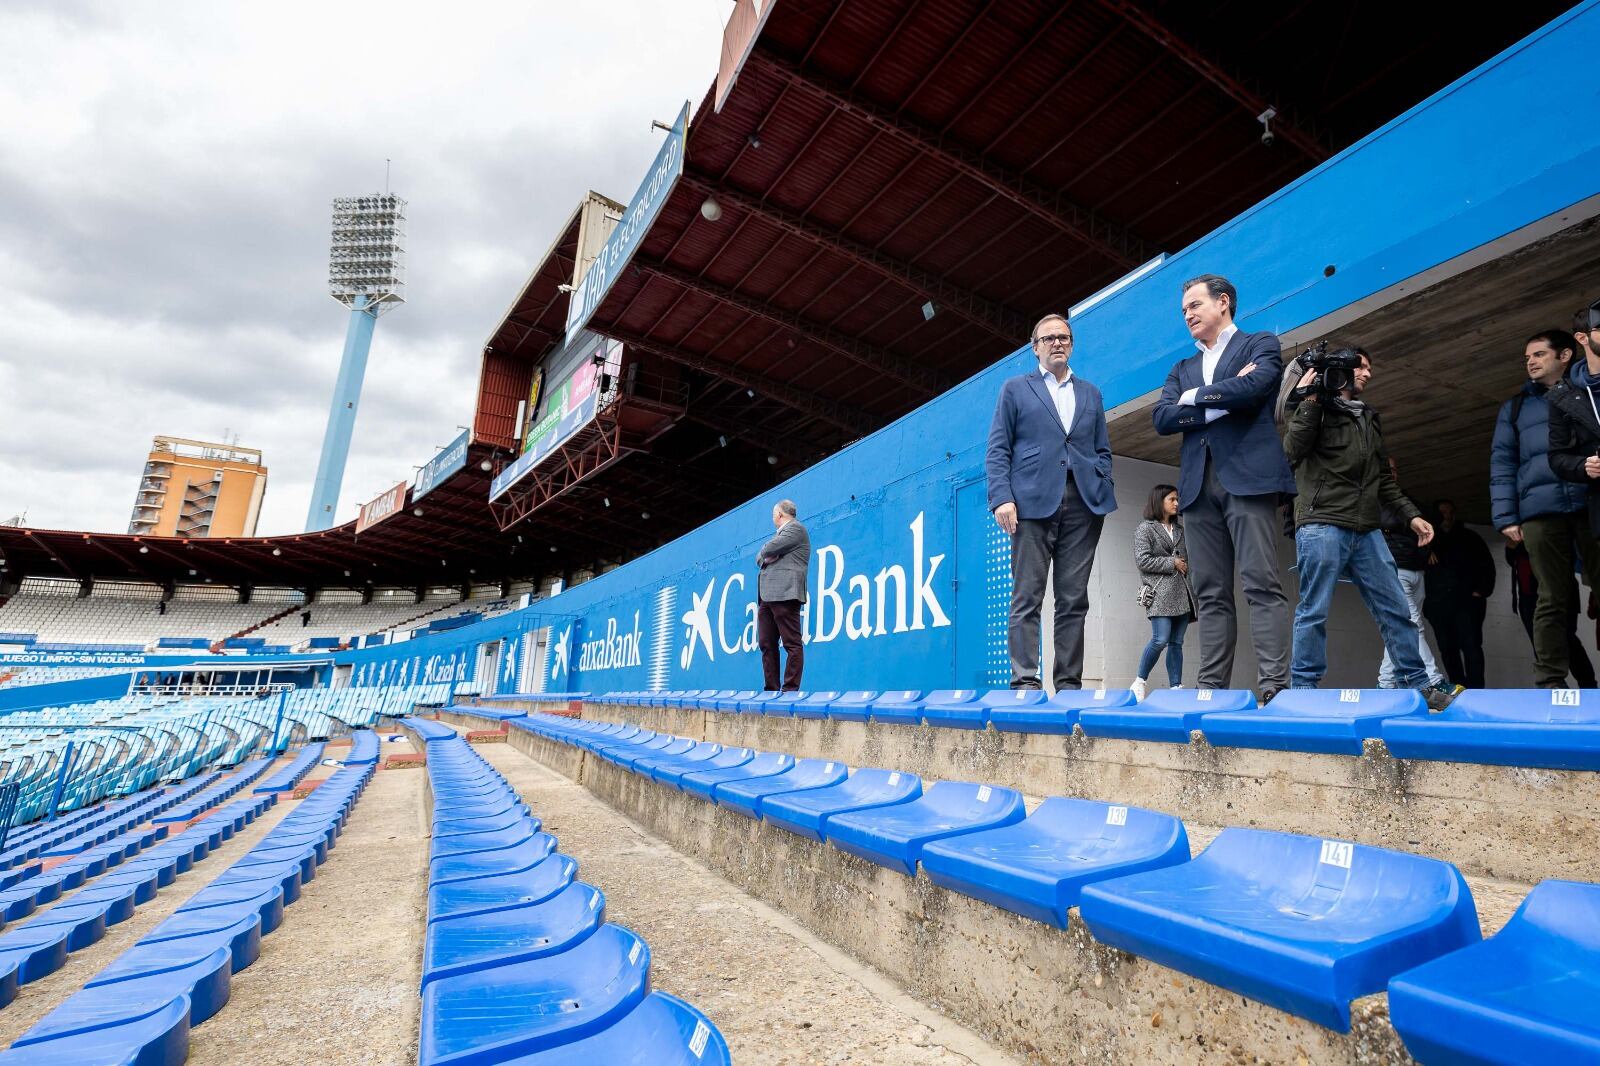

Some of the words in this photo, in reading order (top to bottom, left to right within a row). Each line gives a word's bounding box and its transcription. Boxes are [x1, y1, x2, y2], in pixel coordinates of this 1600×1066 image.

[610, 139, 677, 267] ELECTRICIDAD
[718, 510, 951, 654] CaBank
[569, 608, 643, 673] aixaBank
[0, 654, 39, 663] JUEGO
[97, 656, 146, 664] VIOLENCIA
[1343, 689, 1359, 701] 139
[1553, 690, 1577, 705] 141
[1109, 807, 1126, 824] 139
[1324, 842, 1350, 866] 141
